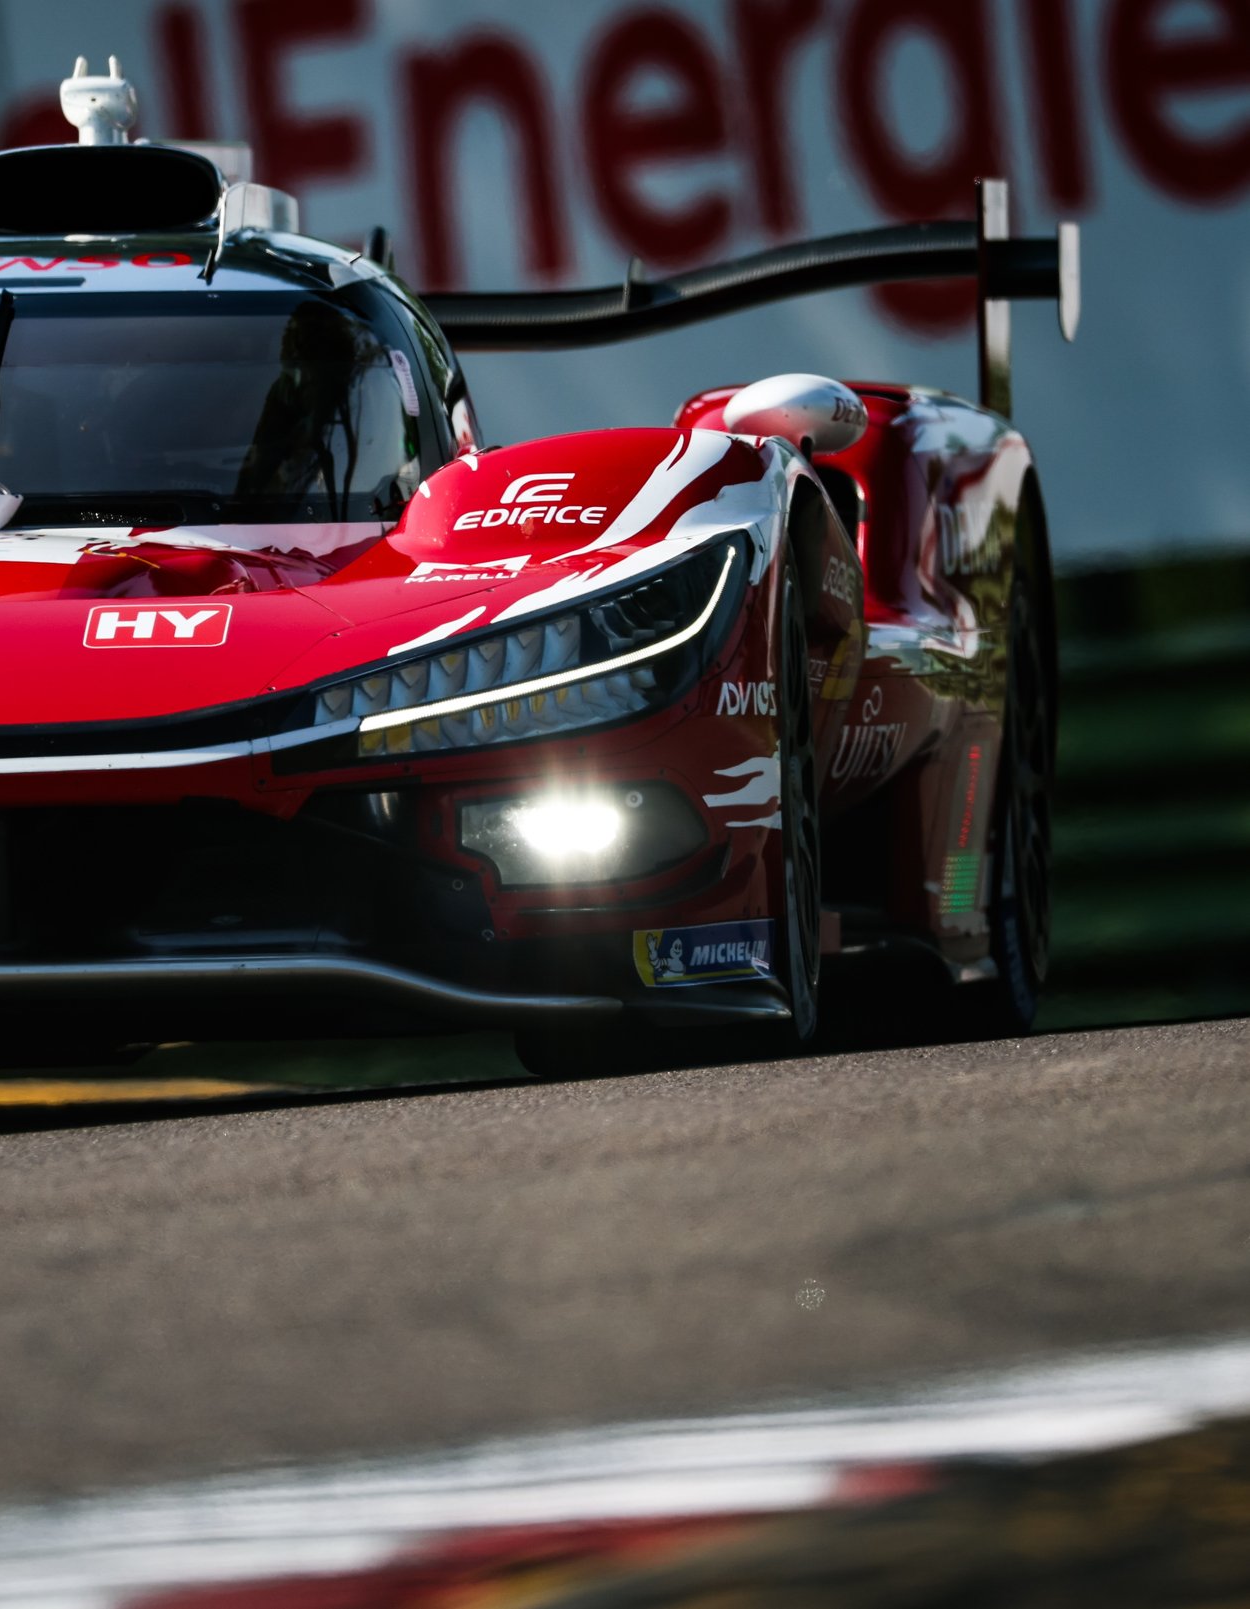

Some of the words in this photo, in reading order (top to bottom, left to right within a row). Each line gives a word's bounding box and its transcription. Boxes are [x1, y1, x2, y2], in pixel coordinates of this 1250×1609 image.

[453, 506, 607, 530] EDIFICE
[404, 572, 518, 584] MARELLI
[95, 610, 220, 639] HY
[716, 681, 777, 716] ADVICS
[689, 940, 767, 966] MICHELIN
